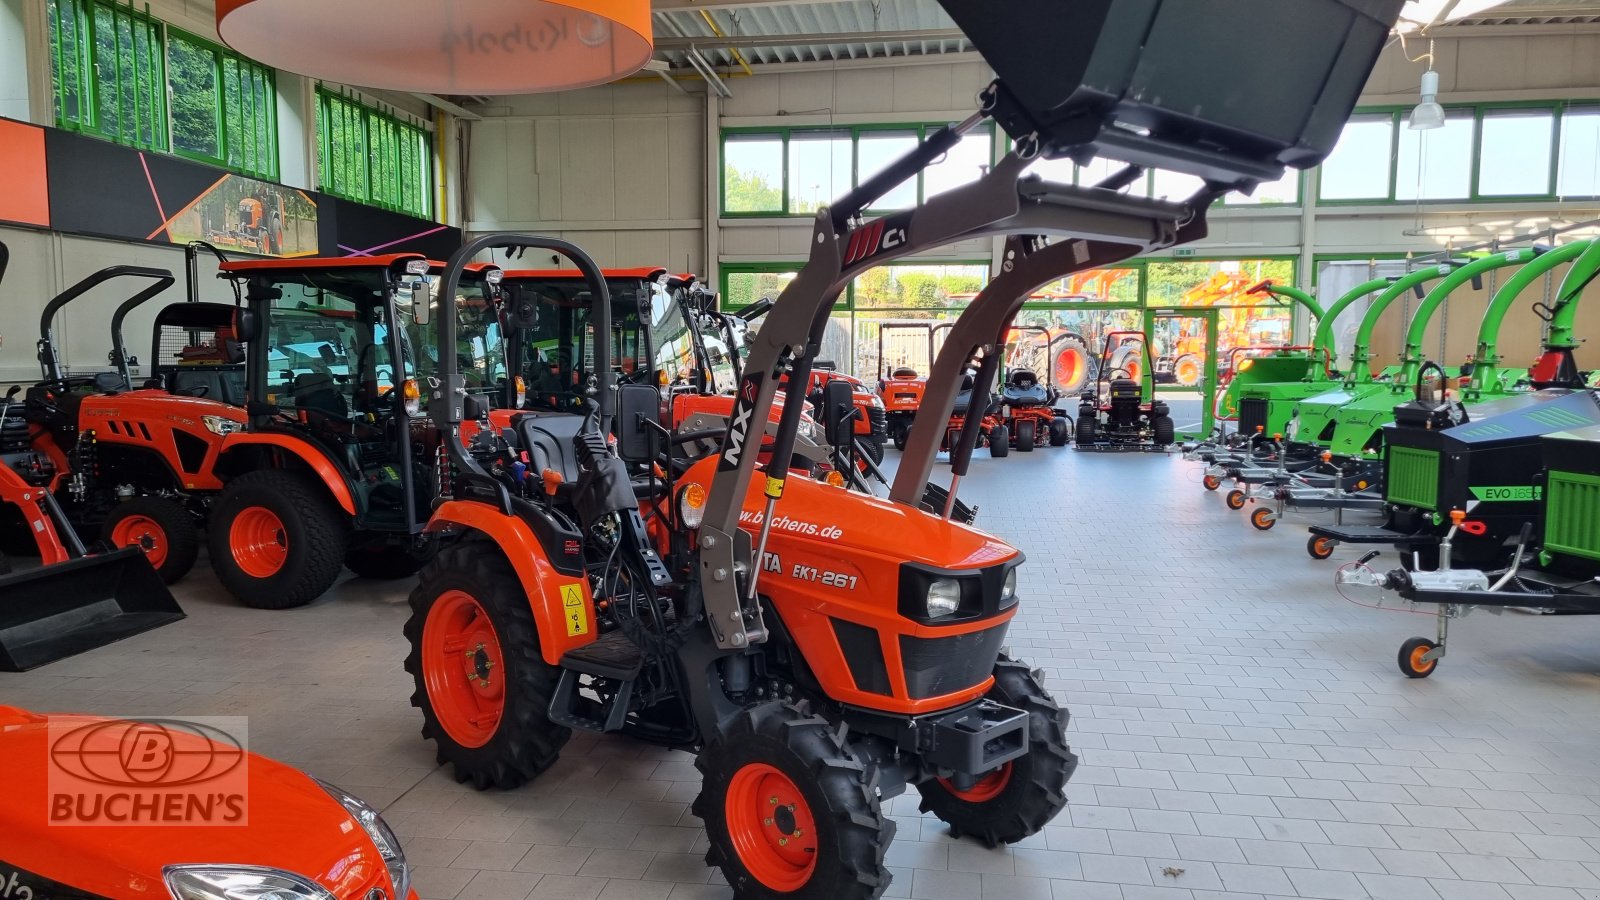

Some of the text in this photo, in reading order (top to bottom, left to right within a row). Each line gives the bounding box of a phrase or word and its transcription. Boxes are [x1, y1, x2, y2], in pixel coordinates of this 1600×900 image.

[724, 400, 753, 466] MX
[1485, 488, 1511, 499] EVO
[792, 564, 858, 590] EK1-261
